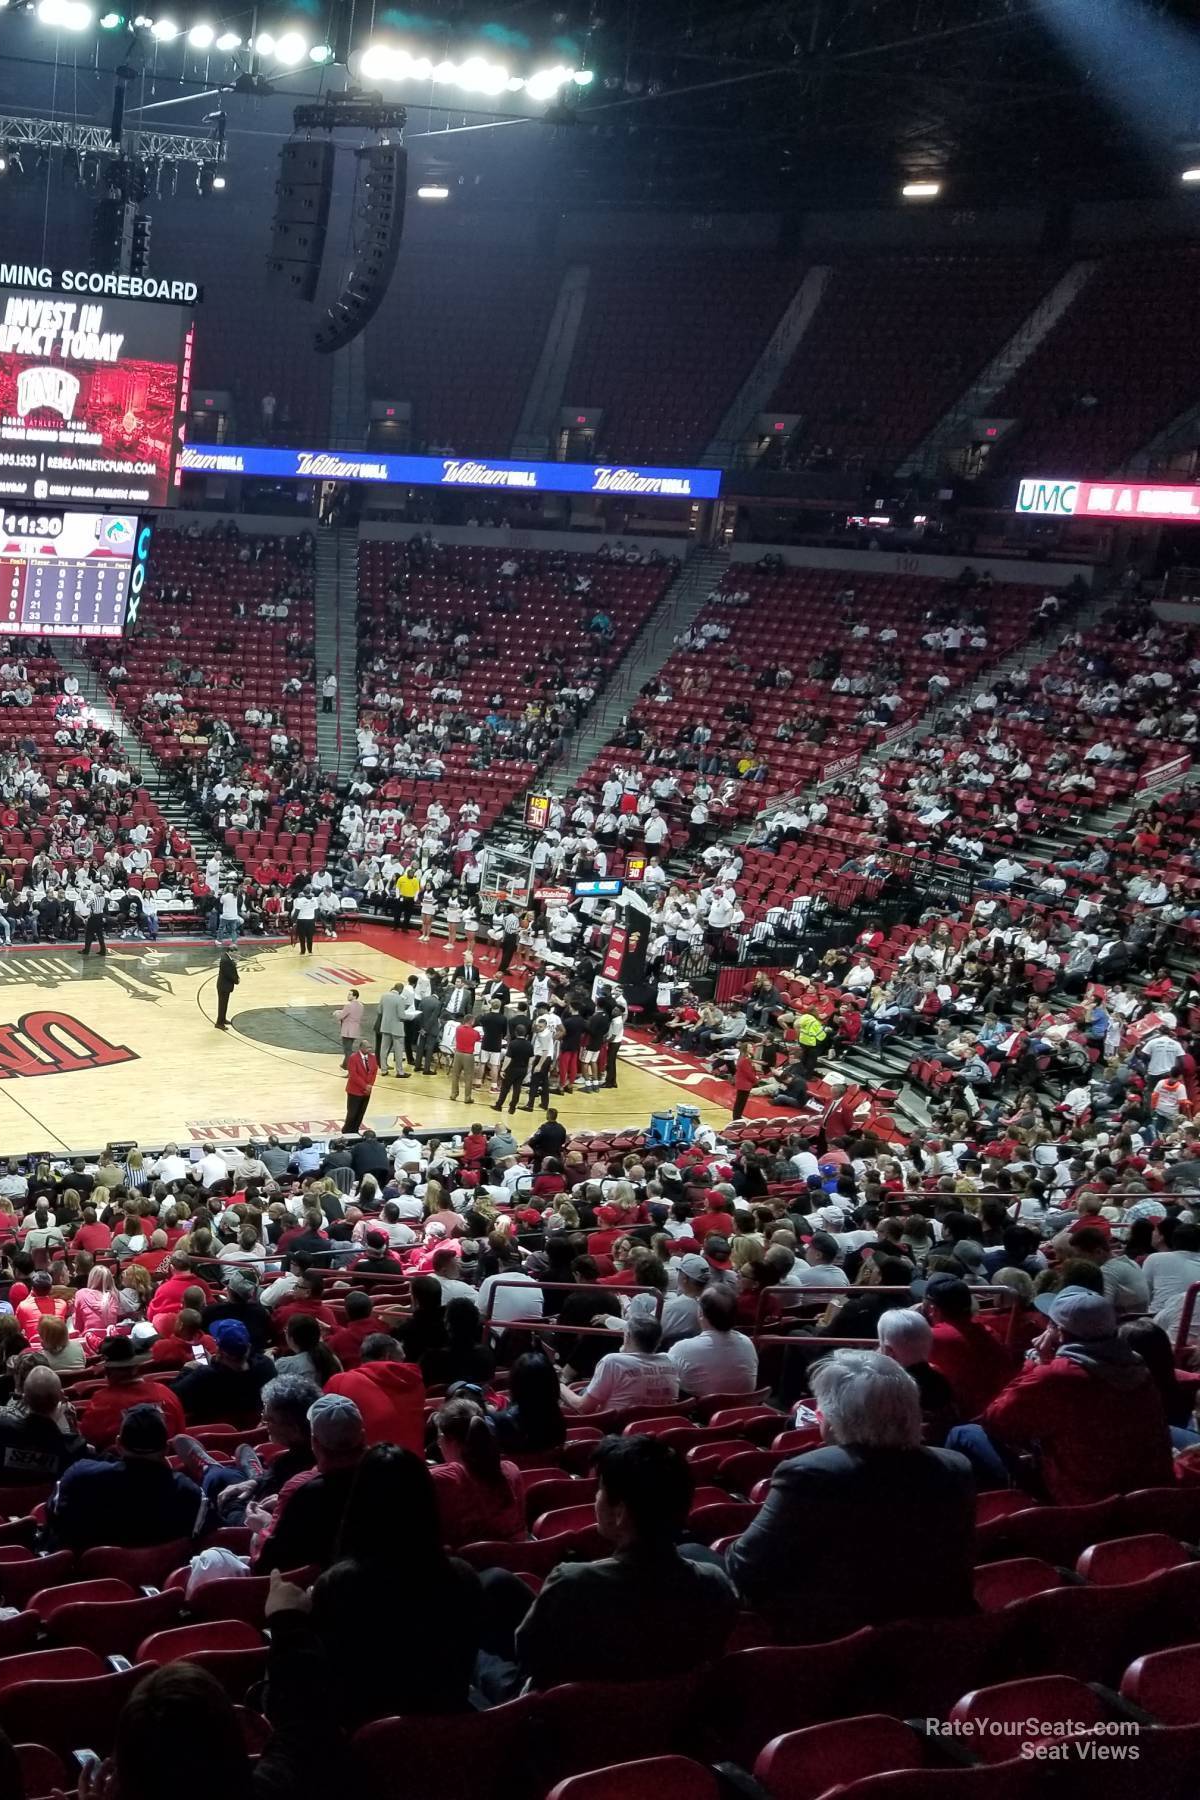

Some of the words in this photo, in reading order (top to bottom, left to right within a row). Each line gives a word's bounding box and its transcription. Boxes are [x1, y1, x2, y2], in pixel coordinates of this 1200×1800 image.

[61, 270, 198, 301] SCOREBOARD
[4, 297, 77, 331] INVEST
[78, 303, 103, 334] IN
[61, 329, 124, 362] TODAY
[28, 418, 64, 429] ATHLETIC
[47, 457, 157, 475] REBELATHLETICFUND.COM
[1019, 484, 1076, 512] UMC
[5, 515, 62, 535] 11:30
[14, 567, 19, 576] 1
[59, 569, 66, 577] 0
[77, 570, 84, 578] 2
[98, 571, 105, 579] 0
[119, 572, 125, 580] 0
[126, 526, 150, 623] COX
[12, 578, 19, 586] 0
[58, 580, 64, 589] 3
[76, 581, 81, 589] 1
[97, 581, 102, 590] 1
[117, 582, 123, 591] 0
[11, 589, 18, 598] 0
[56, 591, 63, 599] 0
[75, 592, 81, 600] 0
[95, 592, 102, 601] 0
[116, 593, 122, 601] 0
[10, 600, 17, 609] 0
[30, 601, 41, 609] 21
[55, 602, 61, 610] 3
[74, 603, 79, 611] 1
[94, 603, 99, 612] 1
[9, 611, 15, 620] 0
[54, 613, 60, 621] 0
[72, 613, 78, 622] 0
[93, 615, 98, 623] 1
[113, 615, 118, 623] 1
[629, 868, 640, 878] 30
